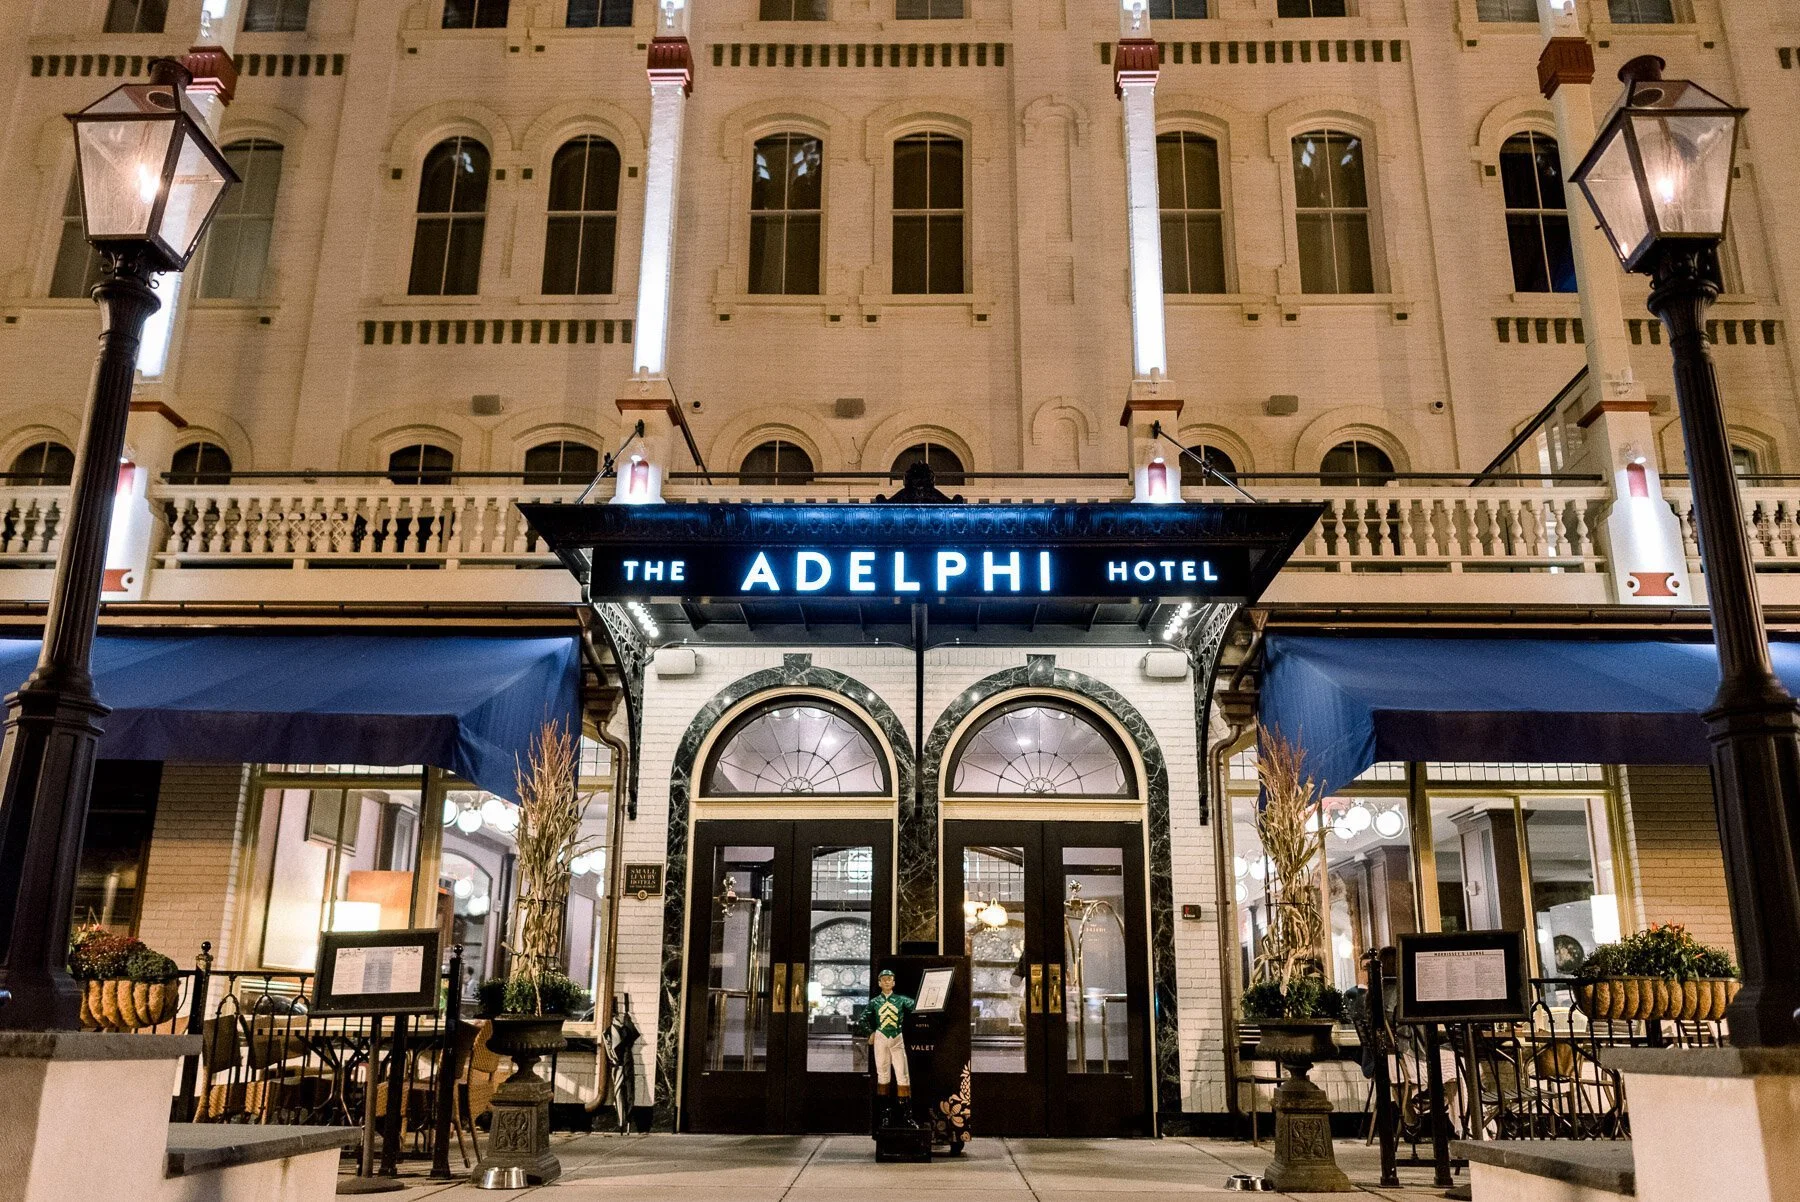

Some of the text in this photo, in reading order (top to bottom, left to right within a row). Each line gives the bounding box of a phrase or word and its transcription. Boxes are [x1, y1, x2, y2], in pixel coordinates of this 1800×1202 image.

[623, 551, 1218, 591] THE ADELPHI HOTEL
